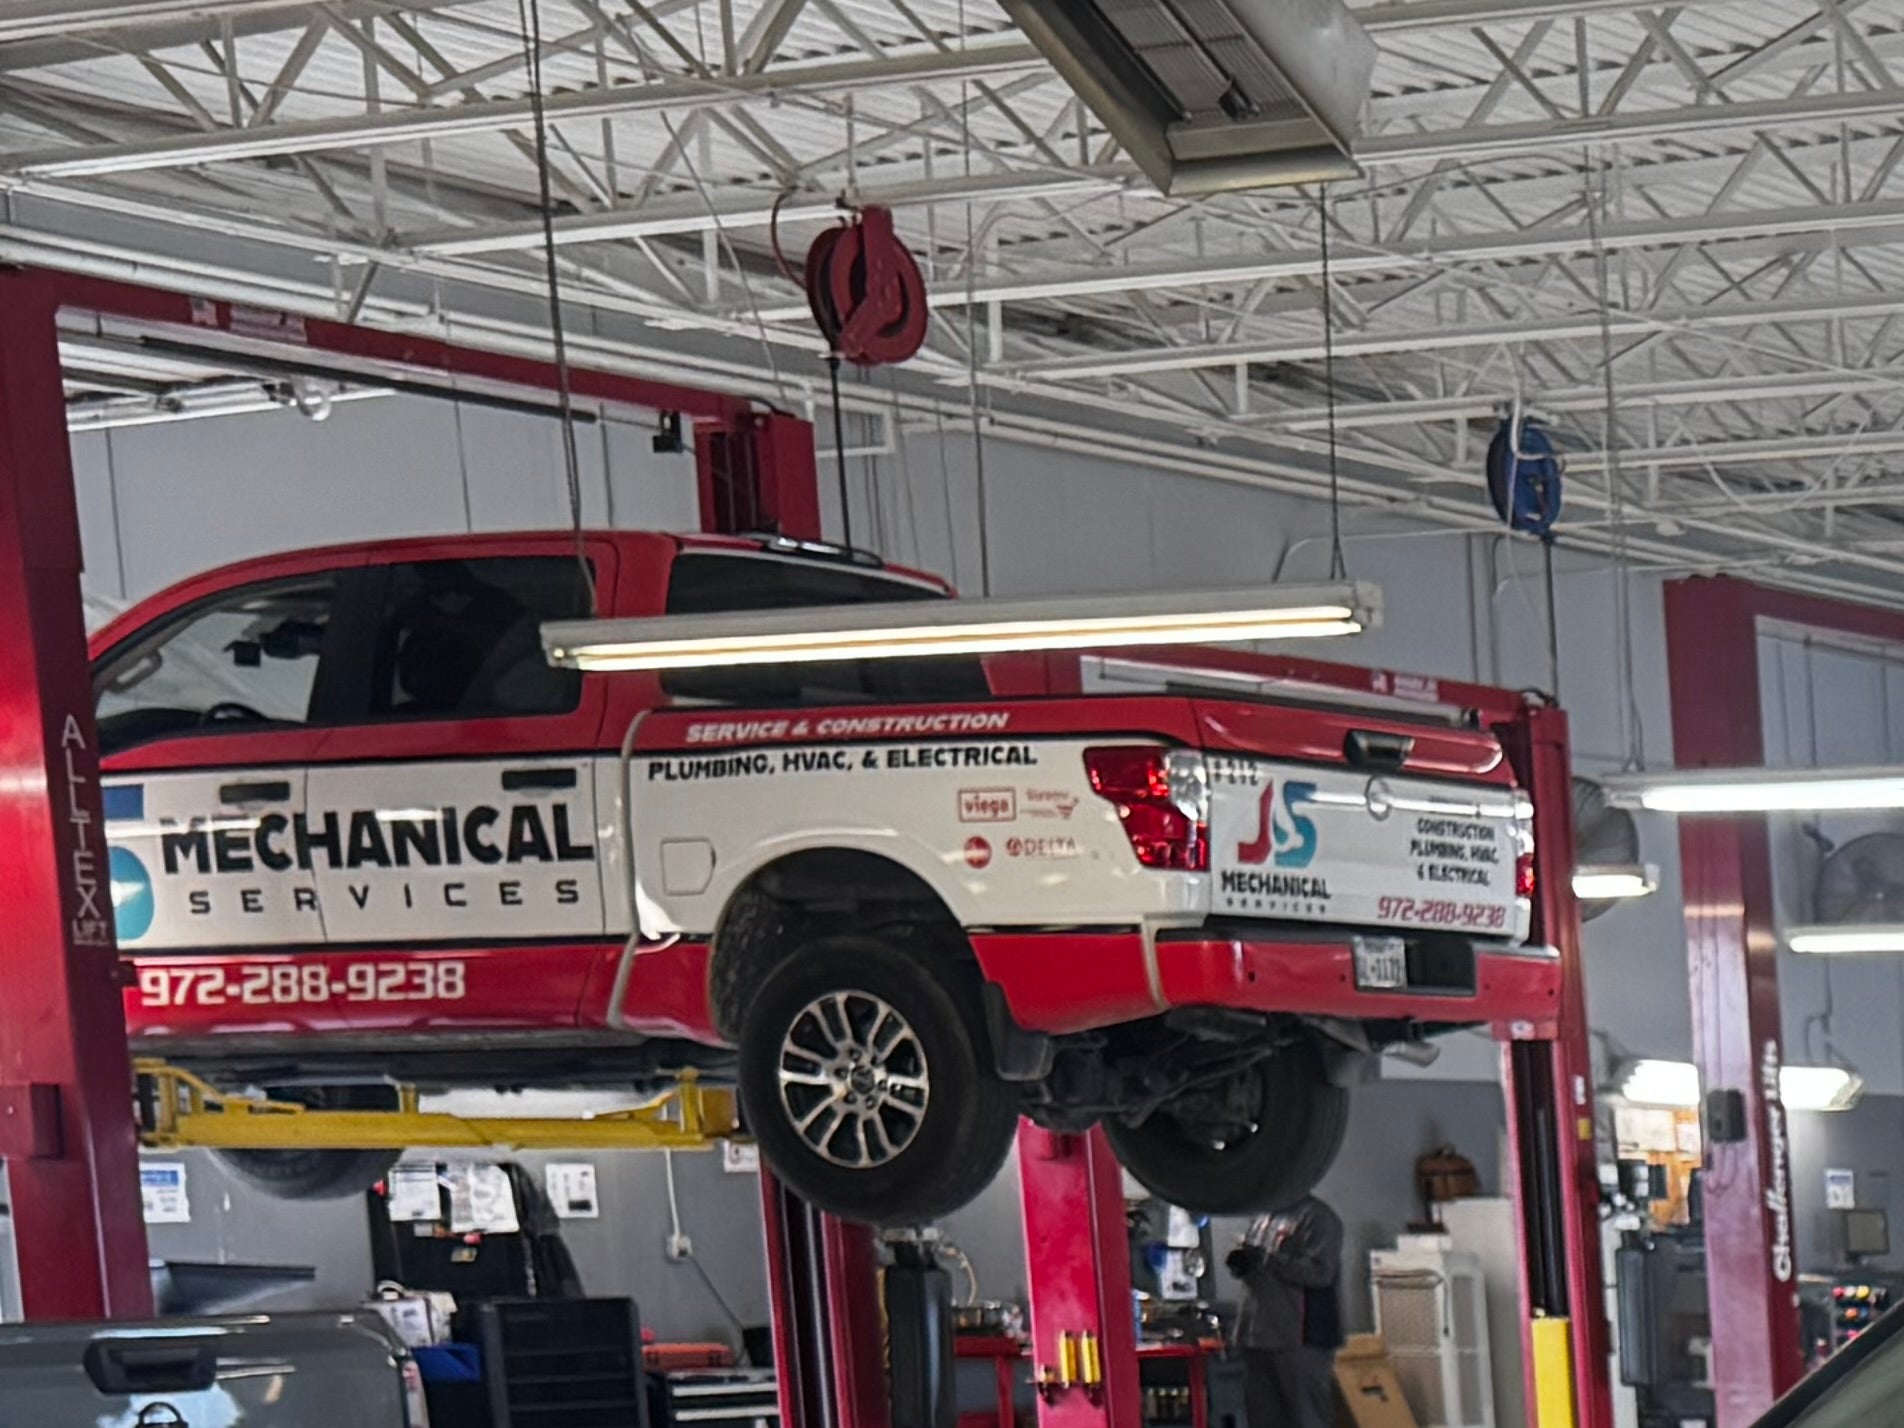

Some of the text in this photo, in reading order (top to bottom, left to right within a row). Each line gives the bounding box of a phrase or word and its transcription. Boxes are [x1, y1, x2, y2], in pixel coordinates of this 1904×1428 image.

[685, 712, 1011, 744] SERVICE & CONSTRUCTION
[647, 744, 1037, 780] PLUMBING, HVAC, & ELECTRICAL
[61, 713, 100, 918] ALLTEX
[1417, 818, 1495, 841] CONSTRUCTION
[158, 803, 595, 875] MECHANICAL
[1221, 869, 1332, 900] MECHANICAL
[1428, 865, 1490, 887] ELECTRICAL
[189, 879, 580, 915] SERVICES
[1378, 896, 1506, 929] 972-288-9238
[140, 961, 467, 1007] 972-288-9238
